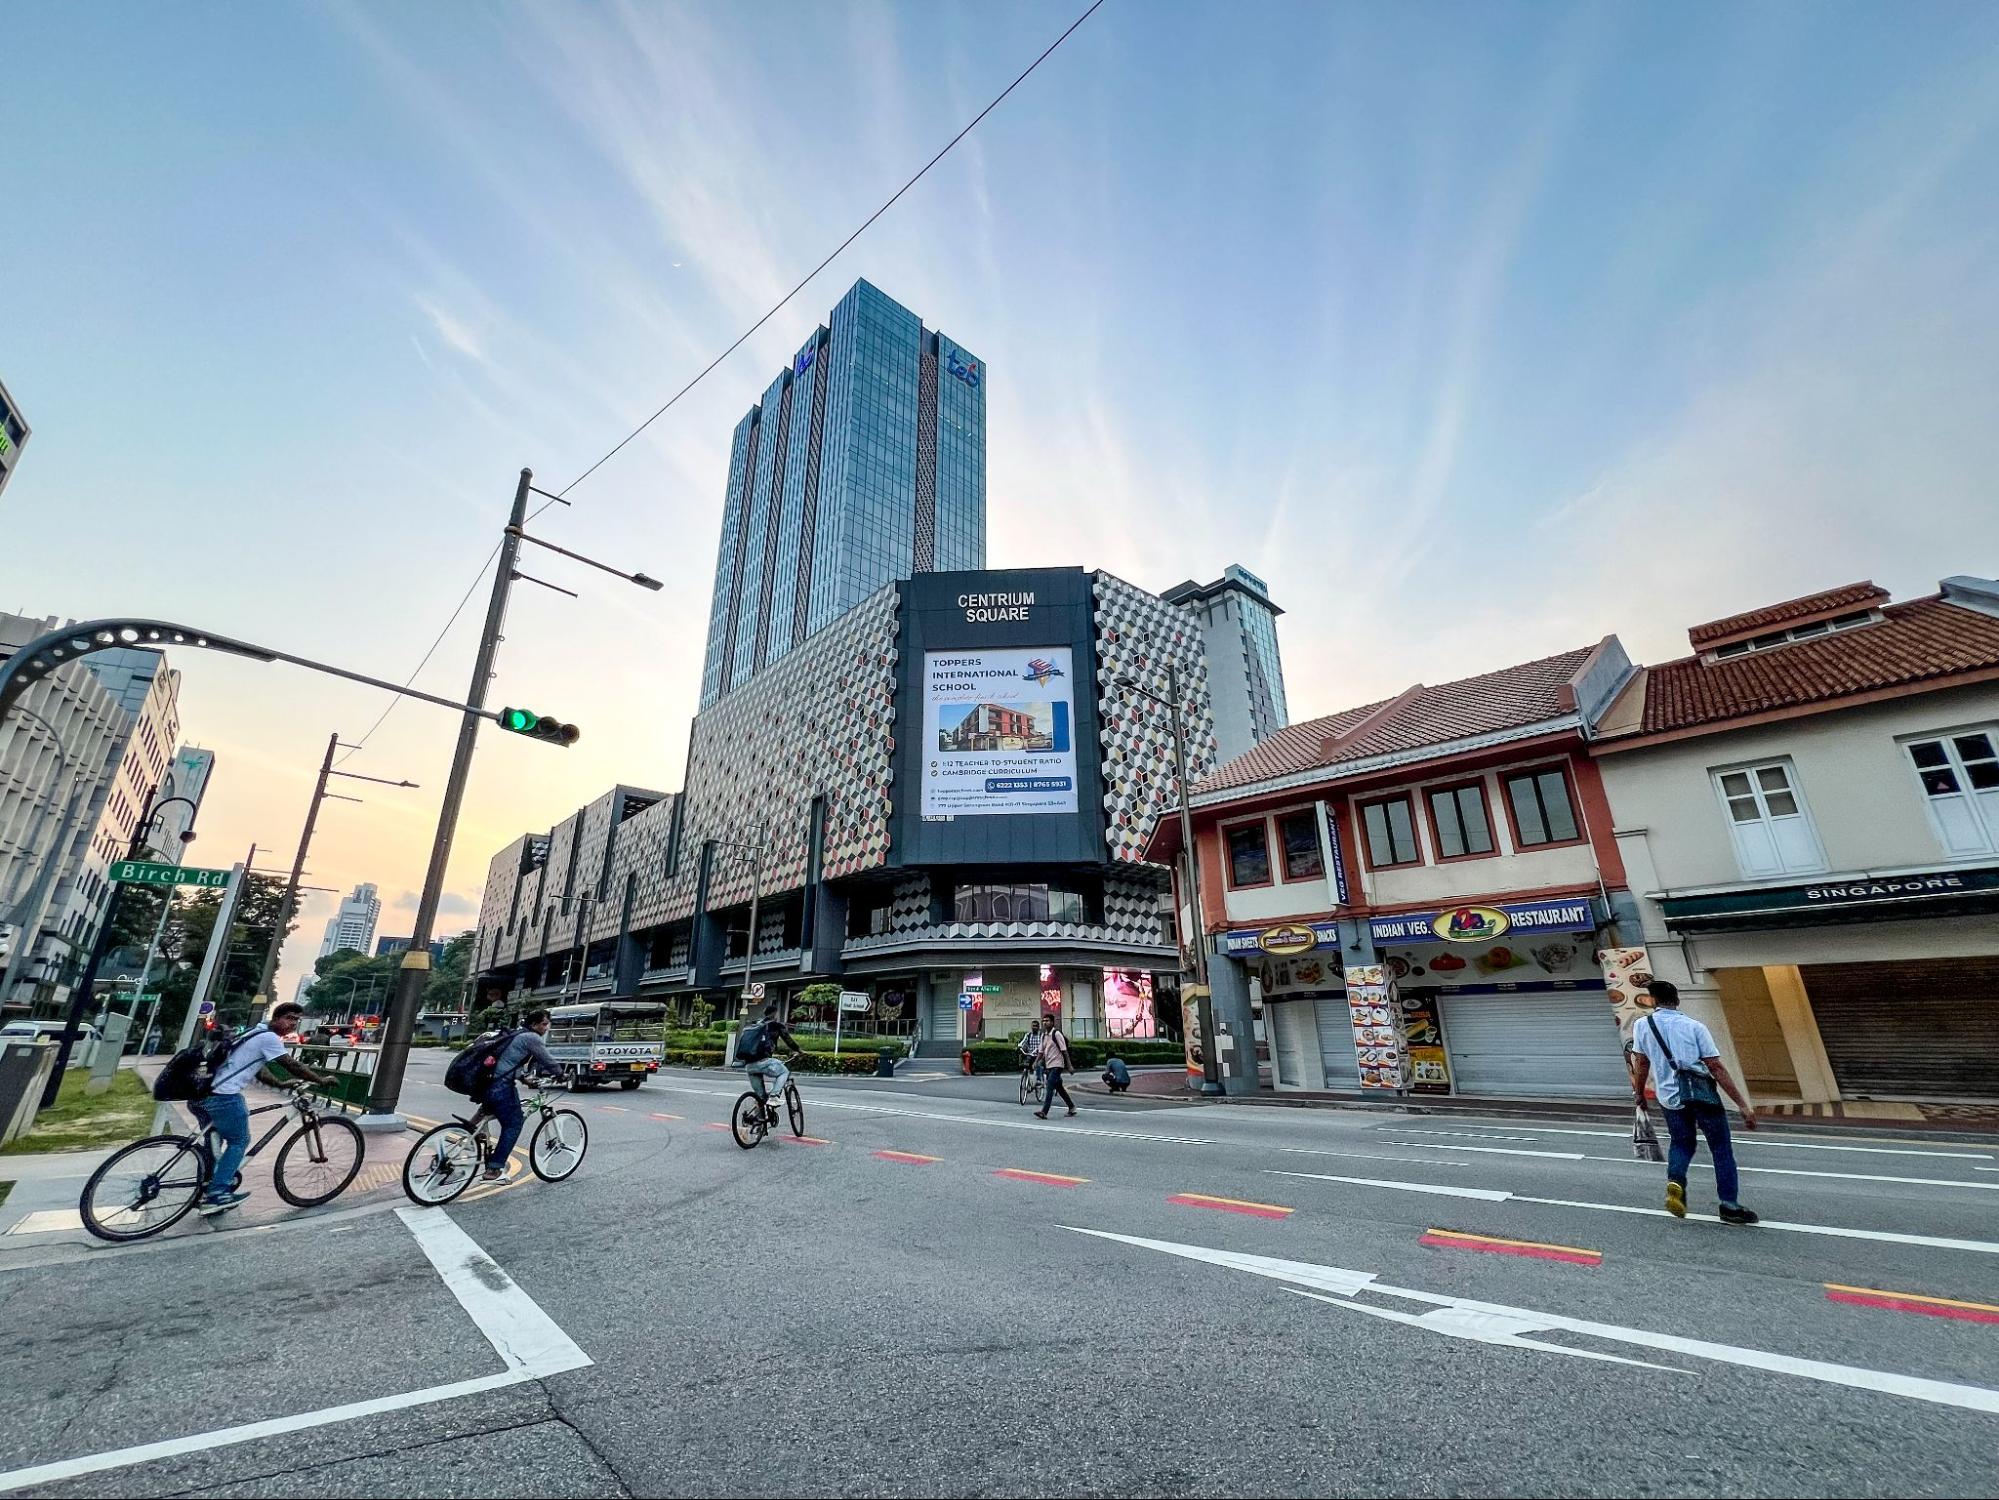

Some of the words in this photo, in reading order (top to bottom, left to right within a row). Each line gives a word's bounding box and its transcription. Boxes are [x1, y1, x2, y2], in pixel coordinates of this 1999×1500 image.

[958, 592, 1035, 607] CENTRIUM
[966, 607, 1029, 622] SQUARE
[933, 659, 981, 667] TOPPERS
[932, 669, 1018, 679] INTERNATIONAL
[932, 683, 976, 692] SCHOOL
[1329, 818, 1343, 879] RESTAURANT
[121, 864, 186, 882] Birch
[197, 870, 224, 885] Rd
[1807, 878, 1963, 899] SINGAPORE
[1373, 923, 1405, 938] INDIAN
[1407, 922, 1431, 936] VEG.
[1510, 906, 1585, 927] RESTAURANT
[1317, 929, 1337, 943] SNACKS
[606, 1047, 652, 1055] TOYOTA
